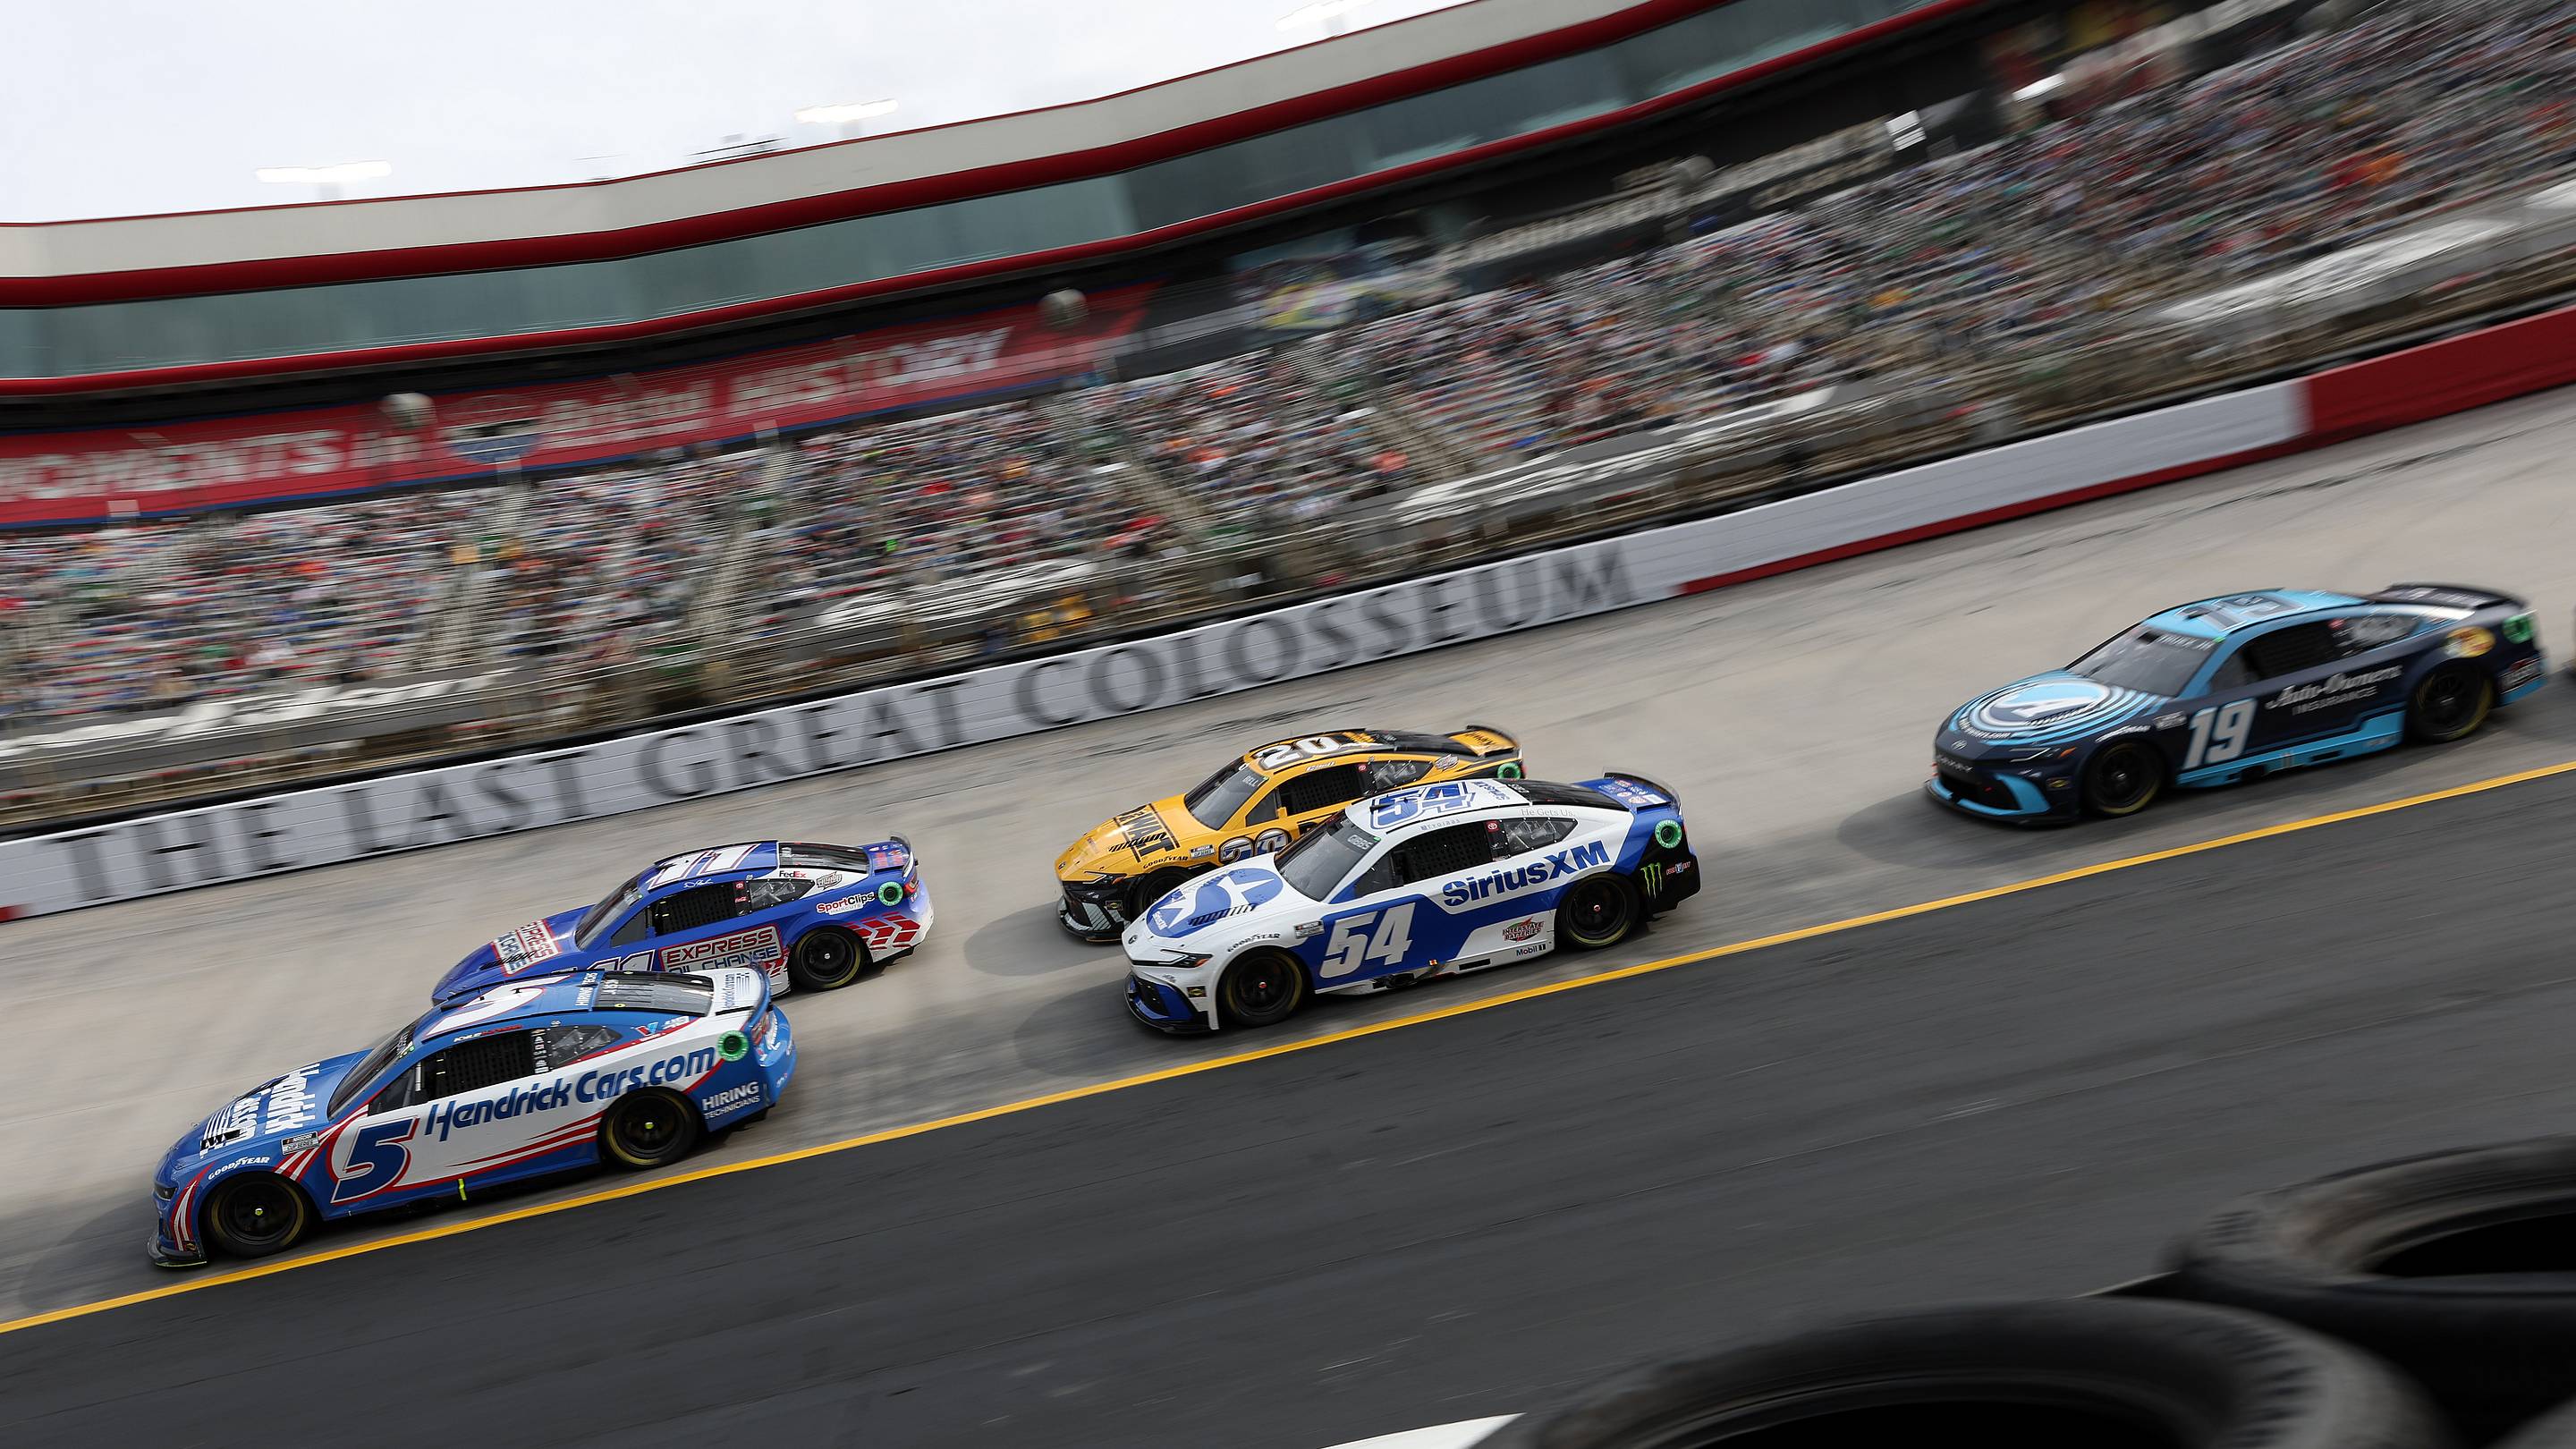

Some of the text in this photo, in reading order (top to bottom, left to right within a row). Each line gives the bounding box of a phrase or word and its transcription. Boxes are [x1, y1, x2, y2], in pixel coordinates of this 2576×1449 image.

[39, 540, 1639, 903] THE LAST GREAT COLOSSEUM
[2183, 697, 2258, 771] 19
[1252, 735, 1342, 771] 20
[1369, 781, 1477, 830] 54
[1521, 808, 1535, 817] He
[1537, 808, 1559, 817] Gets
[779, 870, 807, 878] FedEx
[1142, 854, 1189, 869] GOODYEAR
[1443, 840, 1611, 907] SiriusXM
[817, 894, 875, 912] SportClips
[1319, 902, 1416, 979] 54
[1502, 920, 1546, 936] INTERSTATE
[1504, 927, 1542, 941] BATTERIES
[667, 928, 774, 964] EXPRESS
[1226, 932, 1282, 953] GOODYEAR
[1516, 945, 1538, 956] Mobil
[701, 945, 779, 970] CHANGE
[701, 1080, 759, 1111] HIRING
[703, 1094, 760, 1120] TECHNICIANS
[208, 1156, 271, 1181] GOODYEAR
[331, 1115, 419, 1204] 5
